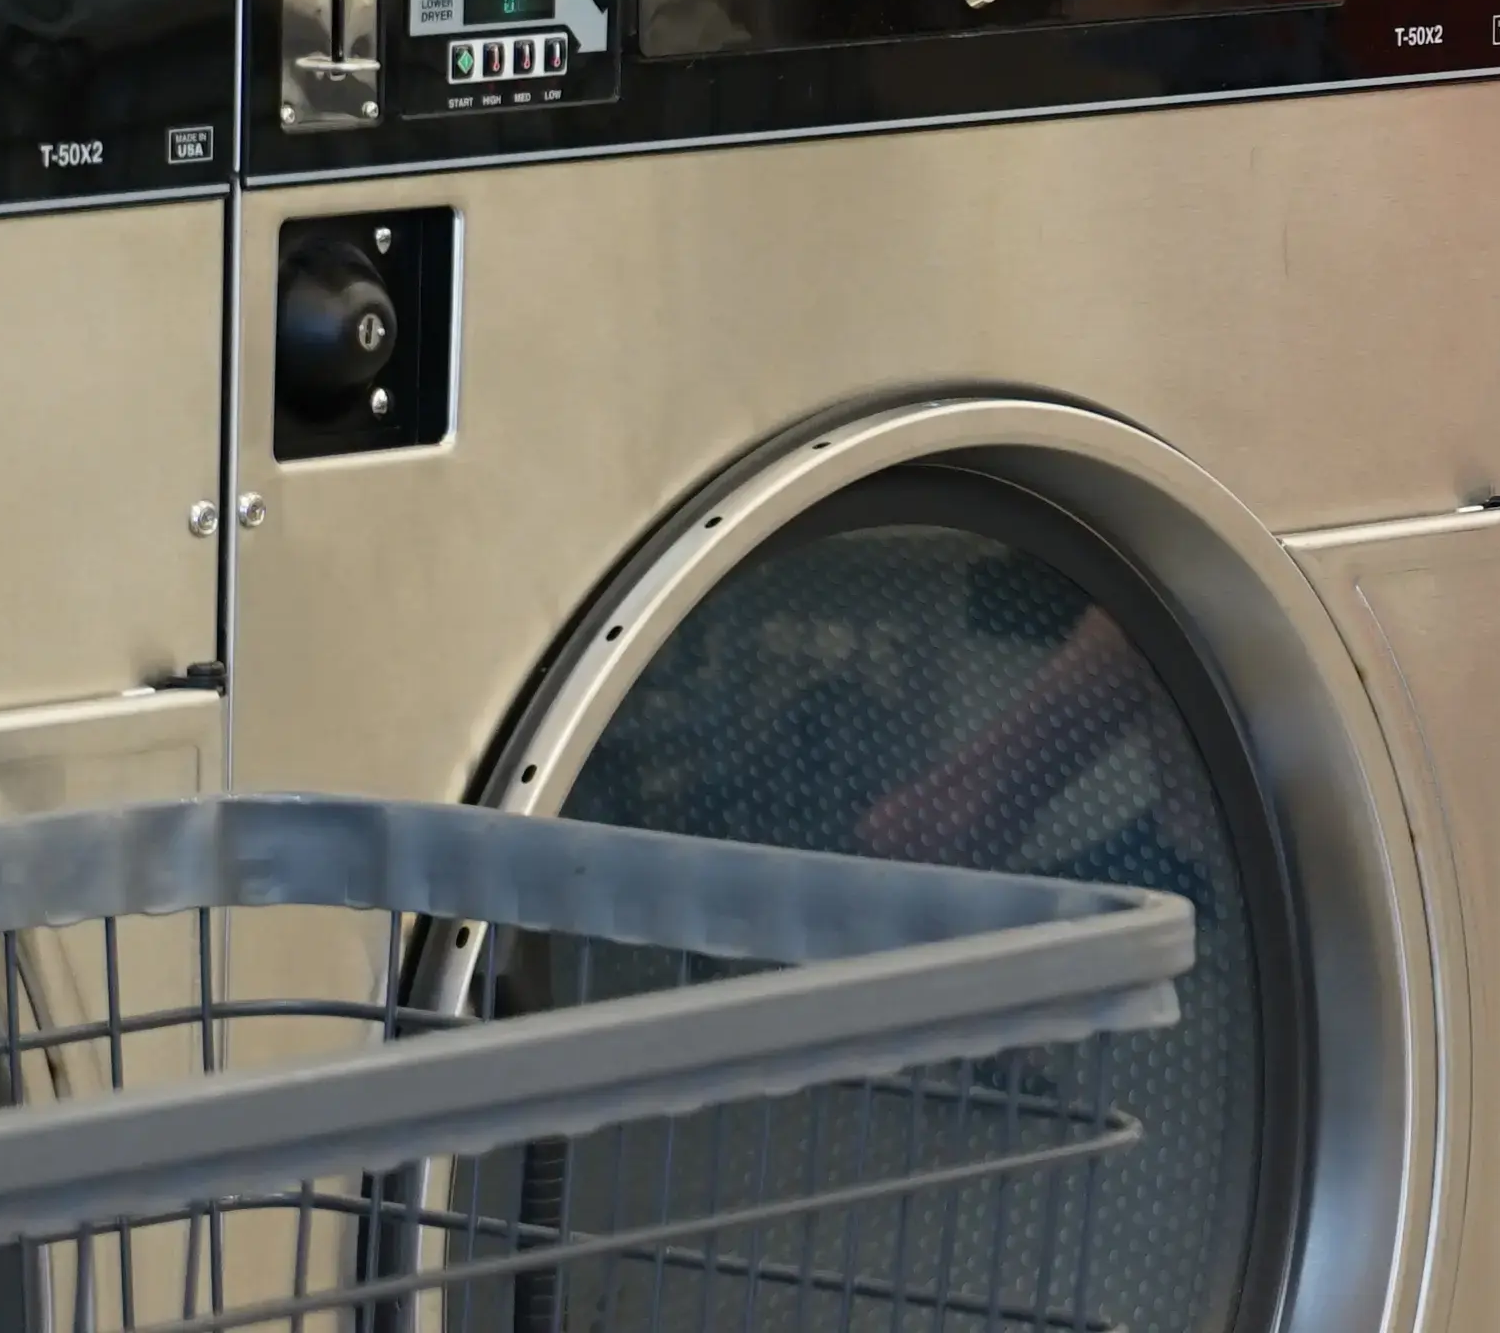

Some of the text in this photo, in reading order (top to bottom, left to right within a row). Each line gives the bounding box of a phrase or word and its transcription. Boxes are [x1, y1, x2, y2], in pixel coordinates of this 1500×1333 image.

[421, 10, 453, 22] DRYER
[1395, 25, 1443, 46] T-50X2
[449, 90, 562, 108] START HIGH MED LOW
[176, 133, 198, 144] MADE
[41, 141, 104, 168] T-50X2
[177, 143, 204, 159] USA
